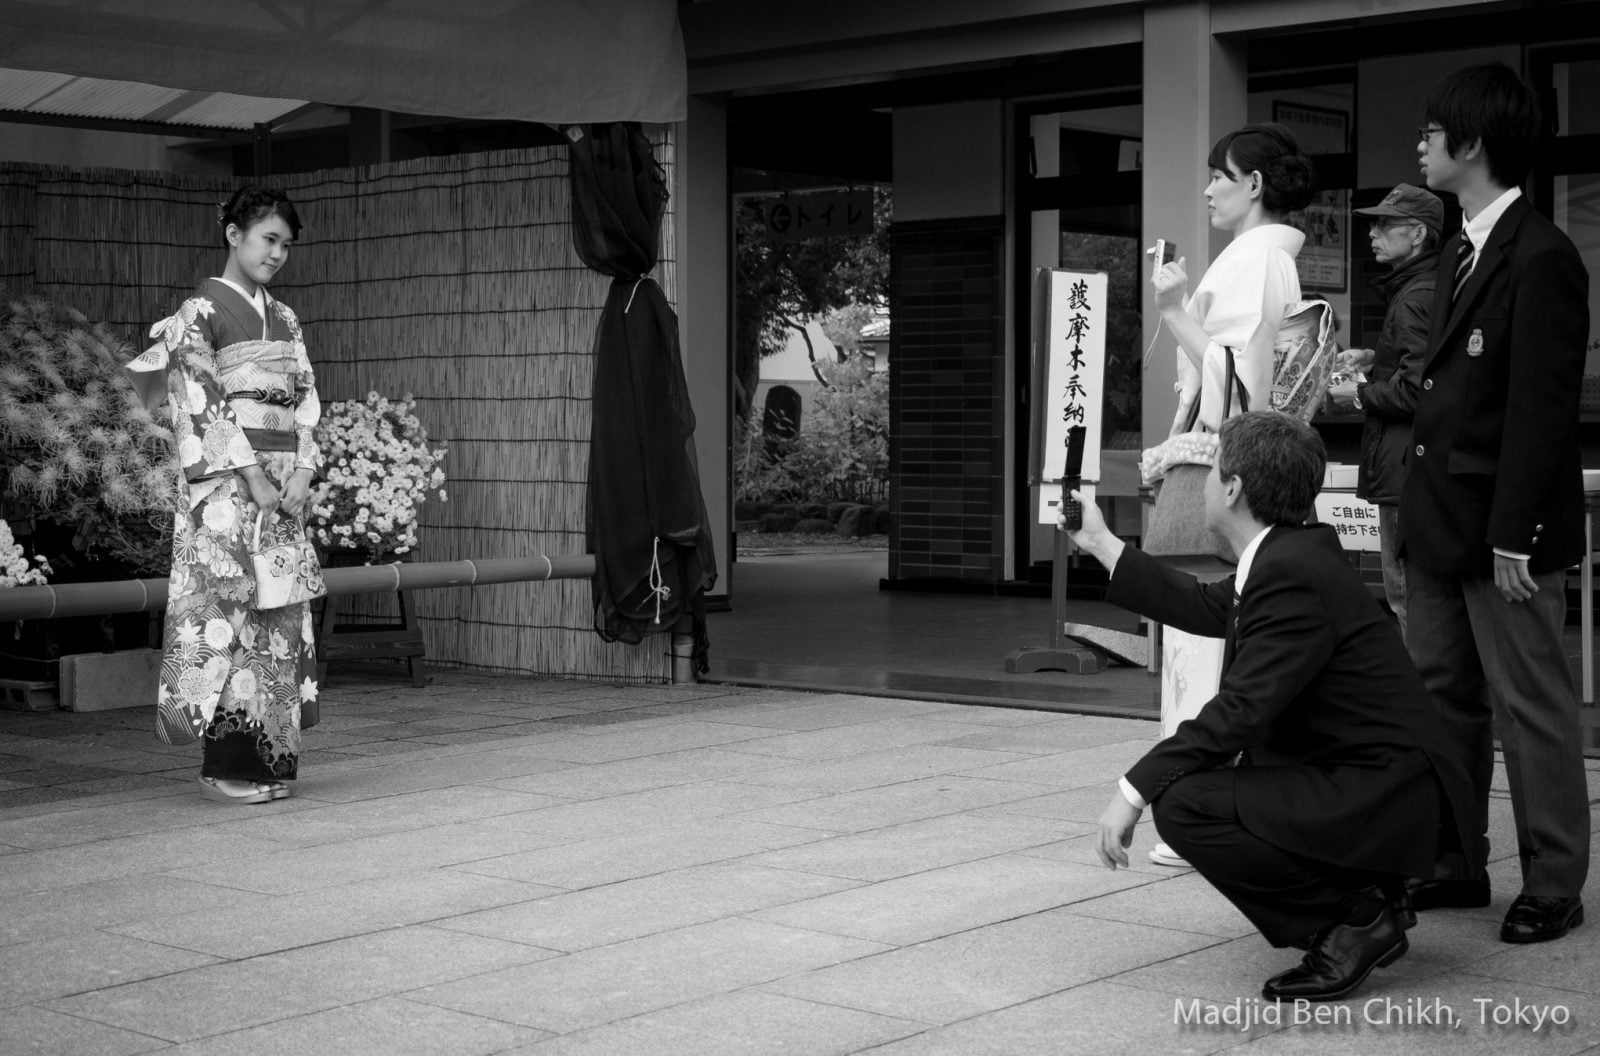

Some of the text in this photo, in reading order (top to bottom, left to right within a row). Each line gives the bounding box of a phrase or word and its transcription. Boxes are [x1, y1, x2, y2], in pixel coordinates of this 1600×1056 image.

[798, 203, 862, 228] トイレ
[1063, 279, 1092, 448] 護摩木奉納
[1332, 506, 1376, 519] ご自由に
